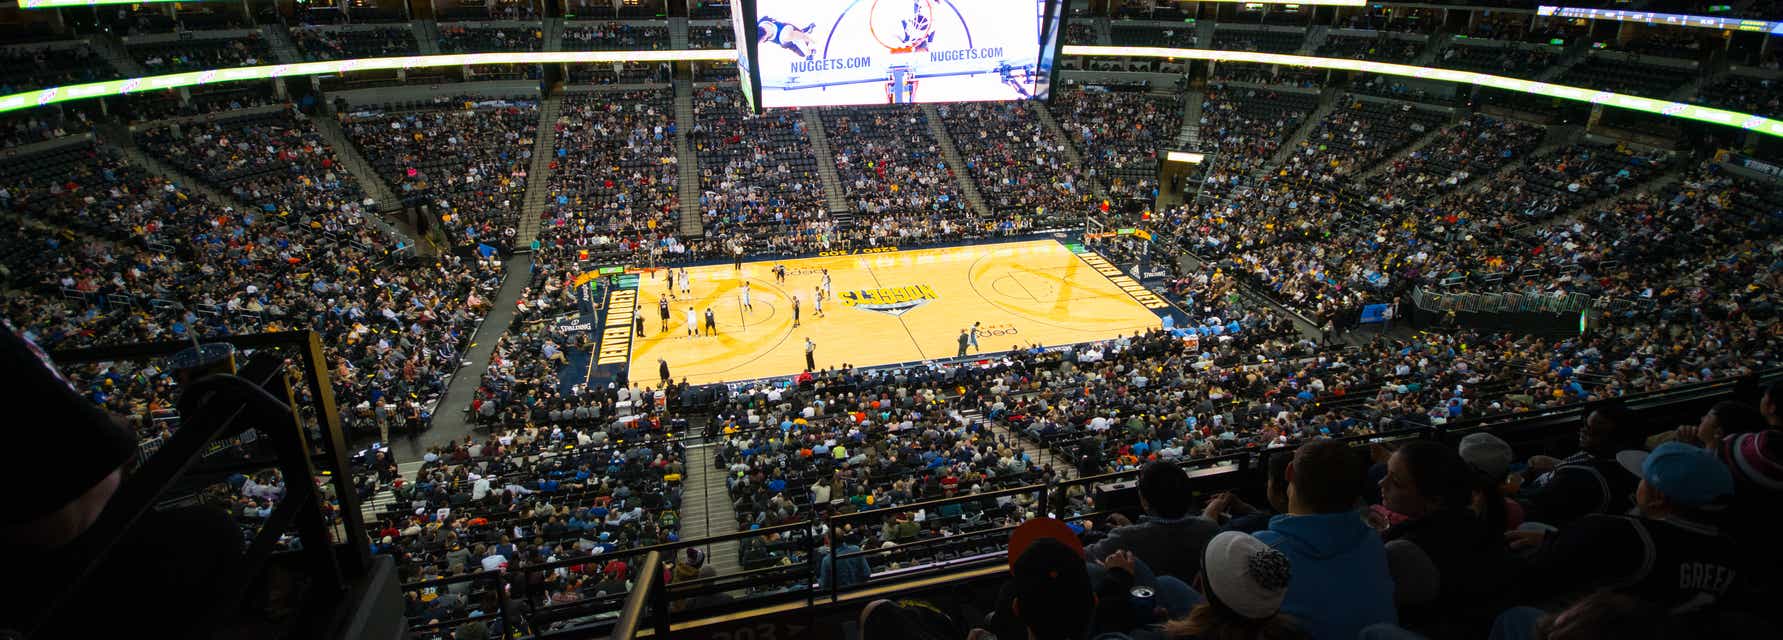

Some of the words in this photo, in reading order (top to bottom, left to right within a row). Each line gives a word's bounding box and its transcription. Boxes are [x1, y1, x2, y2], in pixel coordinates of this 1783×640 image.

[930, 47, 1003, 62] NUGGETS.COM
[790, 57, 871, 73] NUGGETS.COM
[837, 284, 940, 307] NUGGETS
